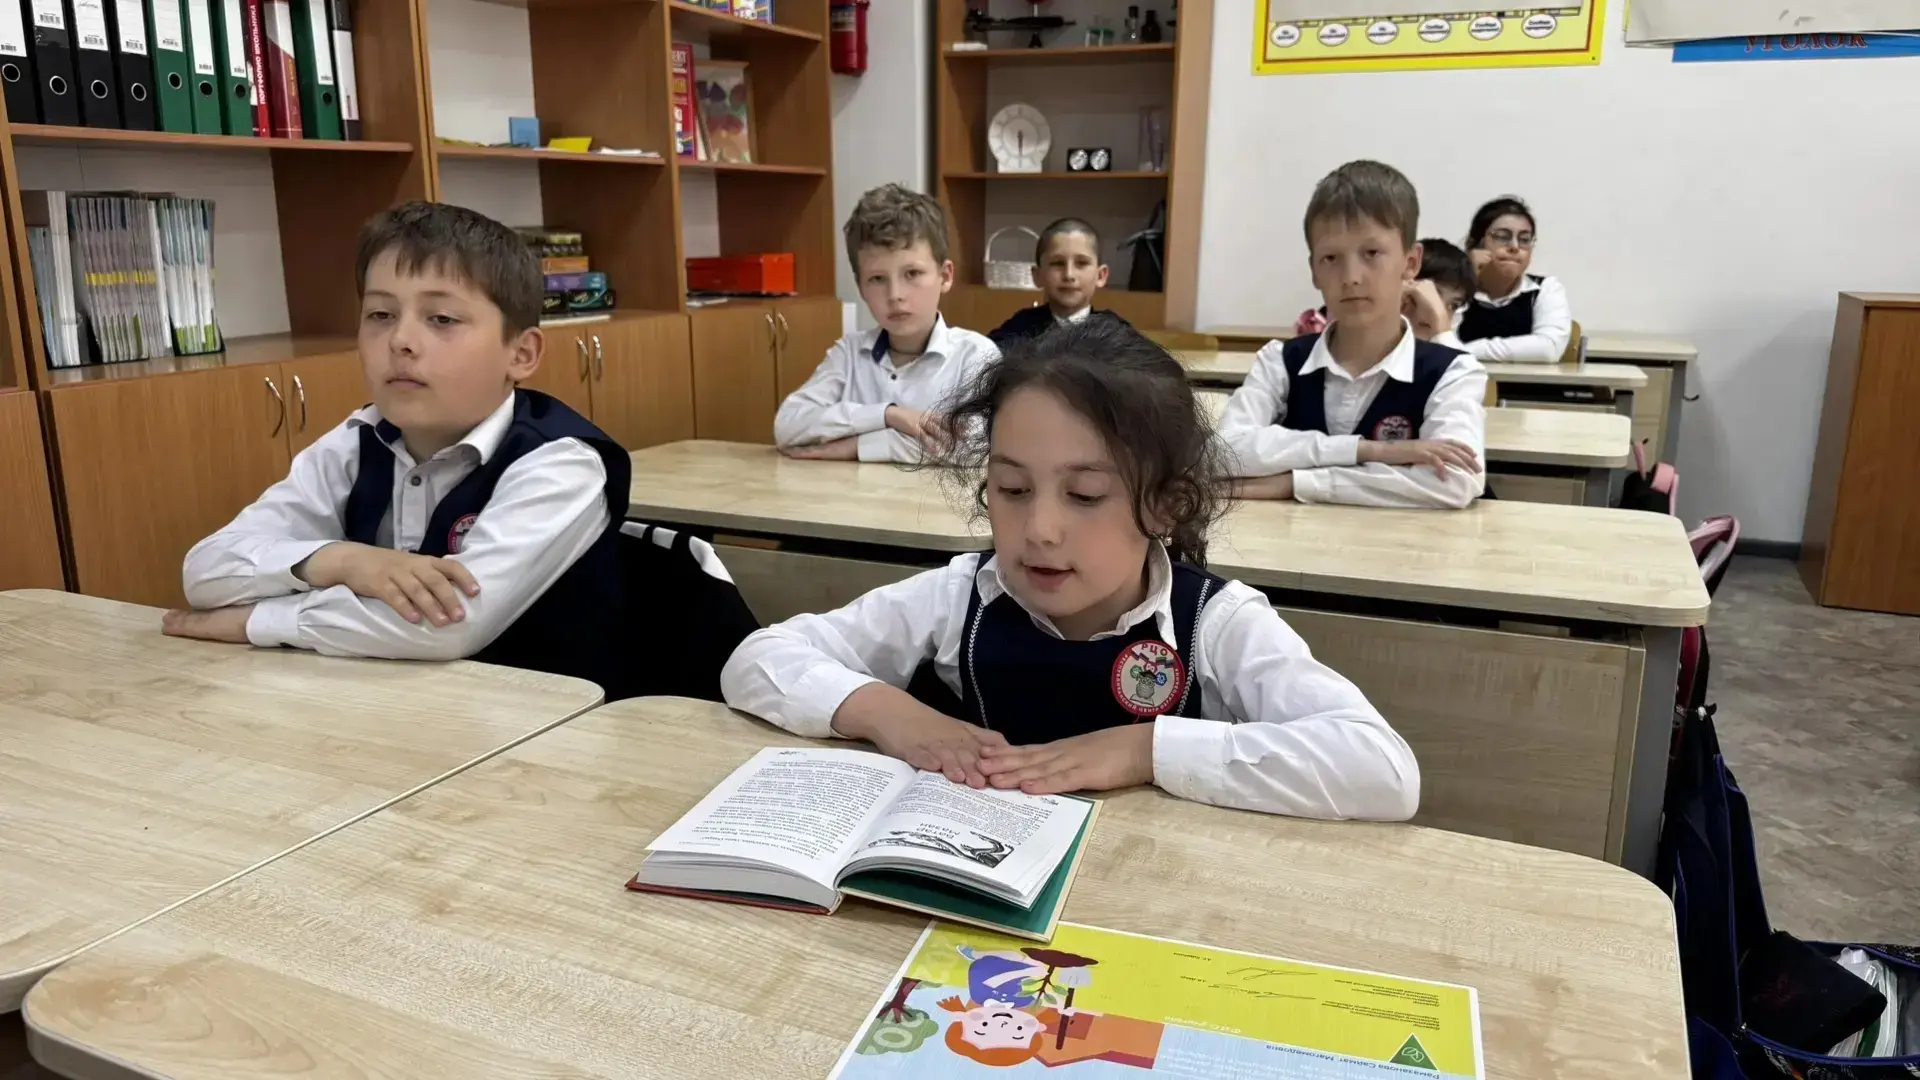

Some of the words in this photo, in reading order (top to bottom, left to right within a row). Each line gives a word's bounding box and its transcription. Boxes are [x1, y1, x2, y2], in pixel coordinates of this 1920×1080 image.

[249, 4, 261, 55] ШКОЛЬНИКА
[255, 56, 266, 105] ПОРТФОЛИО
[1141, 643, 1168, 656] РЦО
[1266, 1044, 1335, 1062] Магомедовна
[1339, 1057, 1377, 1069] Саймат
[1378, 1064, 1440, 1080] Рамазанова
